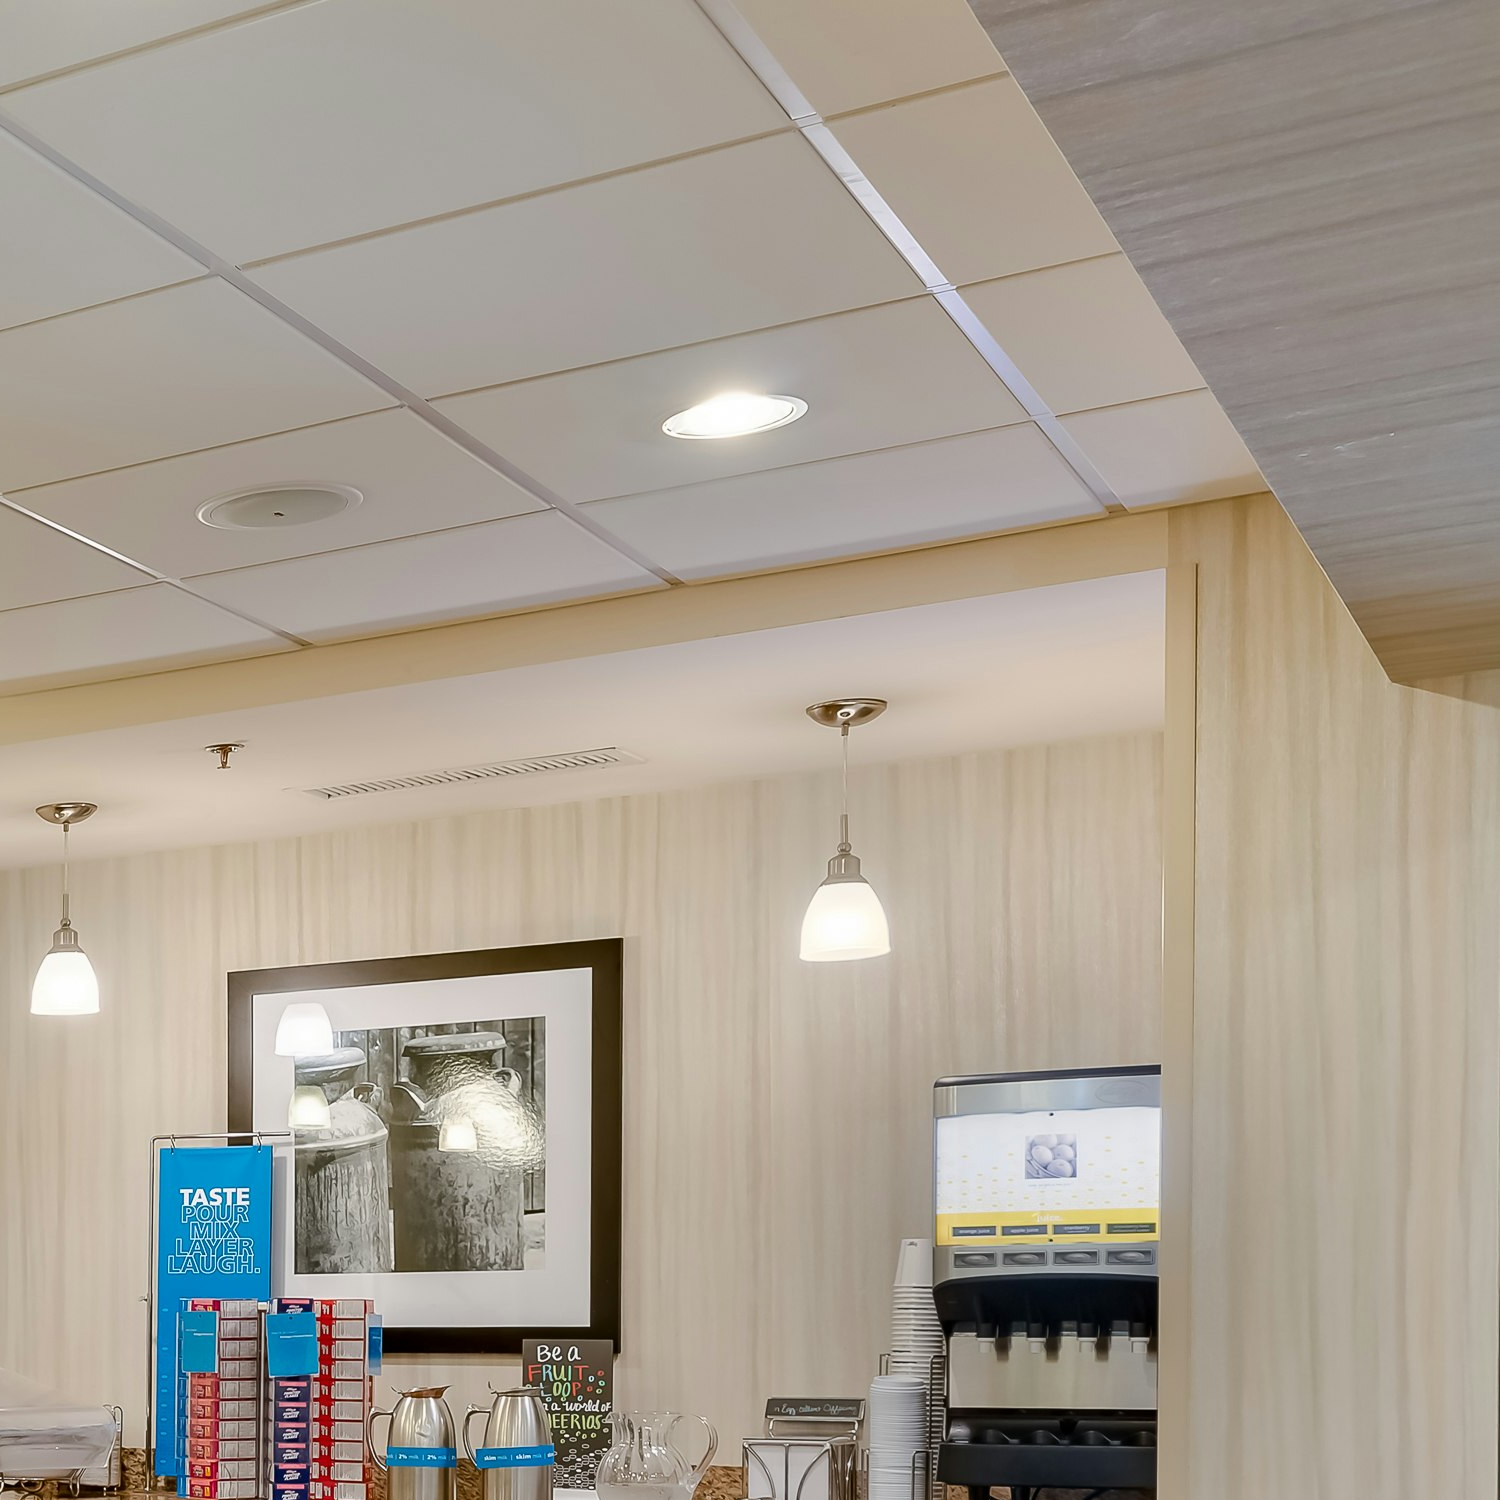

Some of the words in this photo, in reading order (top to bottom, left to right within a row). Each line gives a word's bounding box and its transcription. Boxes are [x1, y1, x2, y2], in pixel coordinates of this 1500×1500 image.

[179, 1187, 250, 1206] TASTE
[181, 1203, 250, 1223] POUR
[189, 1221, 240, 1240] MIX
[175, 1238, 254, 1257] LAYER
[167, 1255, 261, 1274] LAUGH.
[537, 1344, 563, 1362] Be
[567, 1345, 581, 1362] a
[528, 1364, 590, 1382] FRUIT
[540, 1381, 582, 1397] LOOP
[562, 1399, 599, 1412] world
[600, 1401, 612, 1412] of
